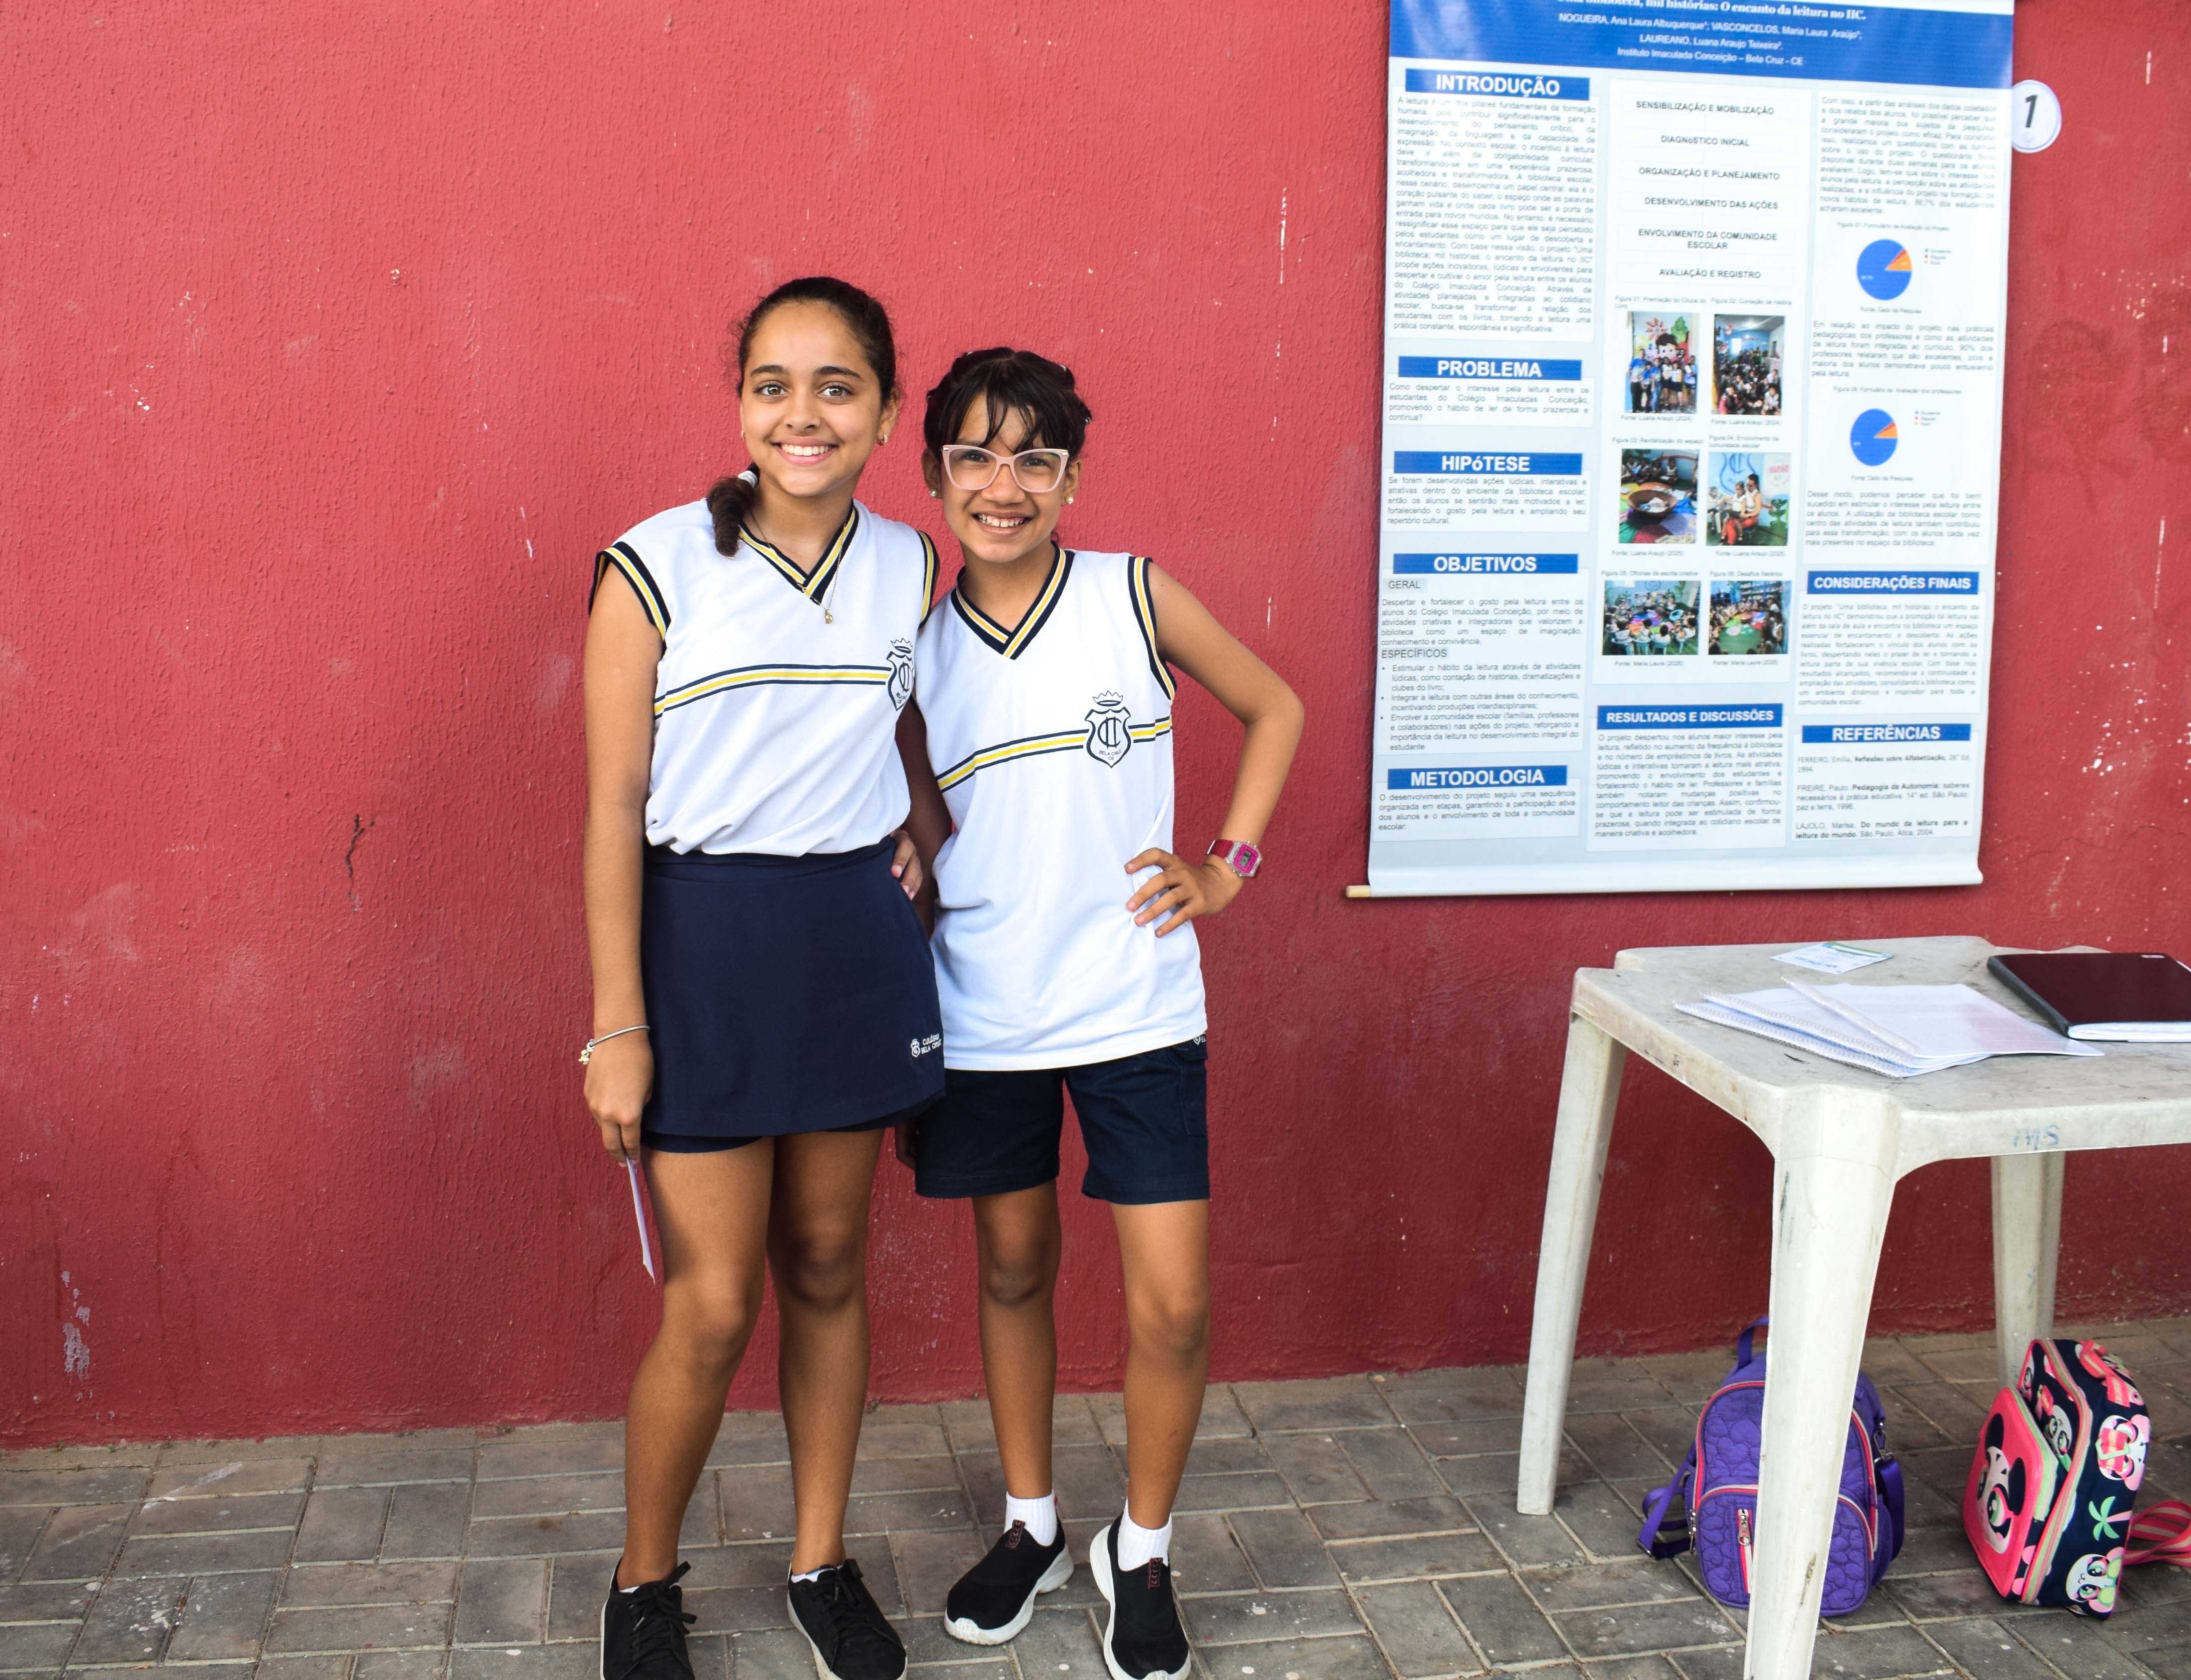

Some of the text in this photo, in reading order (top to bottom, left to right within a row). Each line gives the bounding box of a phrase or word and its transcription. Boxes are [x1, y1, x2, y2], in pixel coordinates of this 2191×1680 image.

[1666, 0, 1718, 11] histórias:
[1720, 1, 1730, 11] O
[1731, 4, 1776, 14] encanto
[1777, 4, 1791, 15] da
[1793, 5, 1828, 17] leitura
[1846, 9, 1866, 20] IIC.
[1559, 12, 1609, 24] NOGUEIRA,
[1610, 15, 1628, 25] Ana
[1628, 17, 1652, 27] Laura
[1711, 21, 1780, 34] VASCONCELOS,
[1782, 25, 1804, 35] Maria
[1805, 28, 1828, 37] Laura
[1640, 34, 1691, 45] LAUREANO,
[1693, 37, 1719, 47] Luana
[1720, 38, 1747, 49] Araujo
[1618, 47, 1650, 57] Instituto
[1651, 49, 1693, 59] Imaculada
[1694, 51, 1737, 62] Conceição
[1745, 53, 1764, 63] Bela
[1765, 55, 1784, 64] Cruz
[1791, 56, 1803, 66] CE
[1436, 74, 1560, 97] INTRODUÇÃO
[1636, 100, 1706, 111] SENSIBILIZAÇÃO
[1716, 105, 1774, 114] MOBILIZAÇÃO
[2025, 94, 2038, 128] 1
[1661, 135, 1718, 145] DIAGNóSTICO
[1639, 167, 1701, 177] ORGANIZAÇÃO
[1712, 170, 1780, 180] PLANEJAMENTO
[1645, 197, 1727, 207] DESENVOLVIMENTO
[1638, 229, 1704, 238] ENVOLVIMENTO
[1720, 232, 1777, 240] COMUNIDADE
[1659, 268, 1707, 277] AVALIAÇÃO
[1438, 360, 1542, 378] PROBLEMA
[1458, 394, 1485, 403] Colégio
[1442, 456, 1530, 472] HIPóTESE
[1434, 556, 1537, 572] OBJETIVOS
[1388, 580, 1421, 589] GERAL
[1815, 576, 1971, 590] CONSIDERAÇÕES FINAIS
[1382, 649, 1448, 658] ESPECÍFICOS
[1607, 709, 1774, 723] RESULTADOS E DISCUSSÕES
[1832, 725, 1941, 741] REFERÊNCIAS
[1411, 769, 1545, 786] METODOLOGIA
